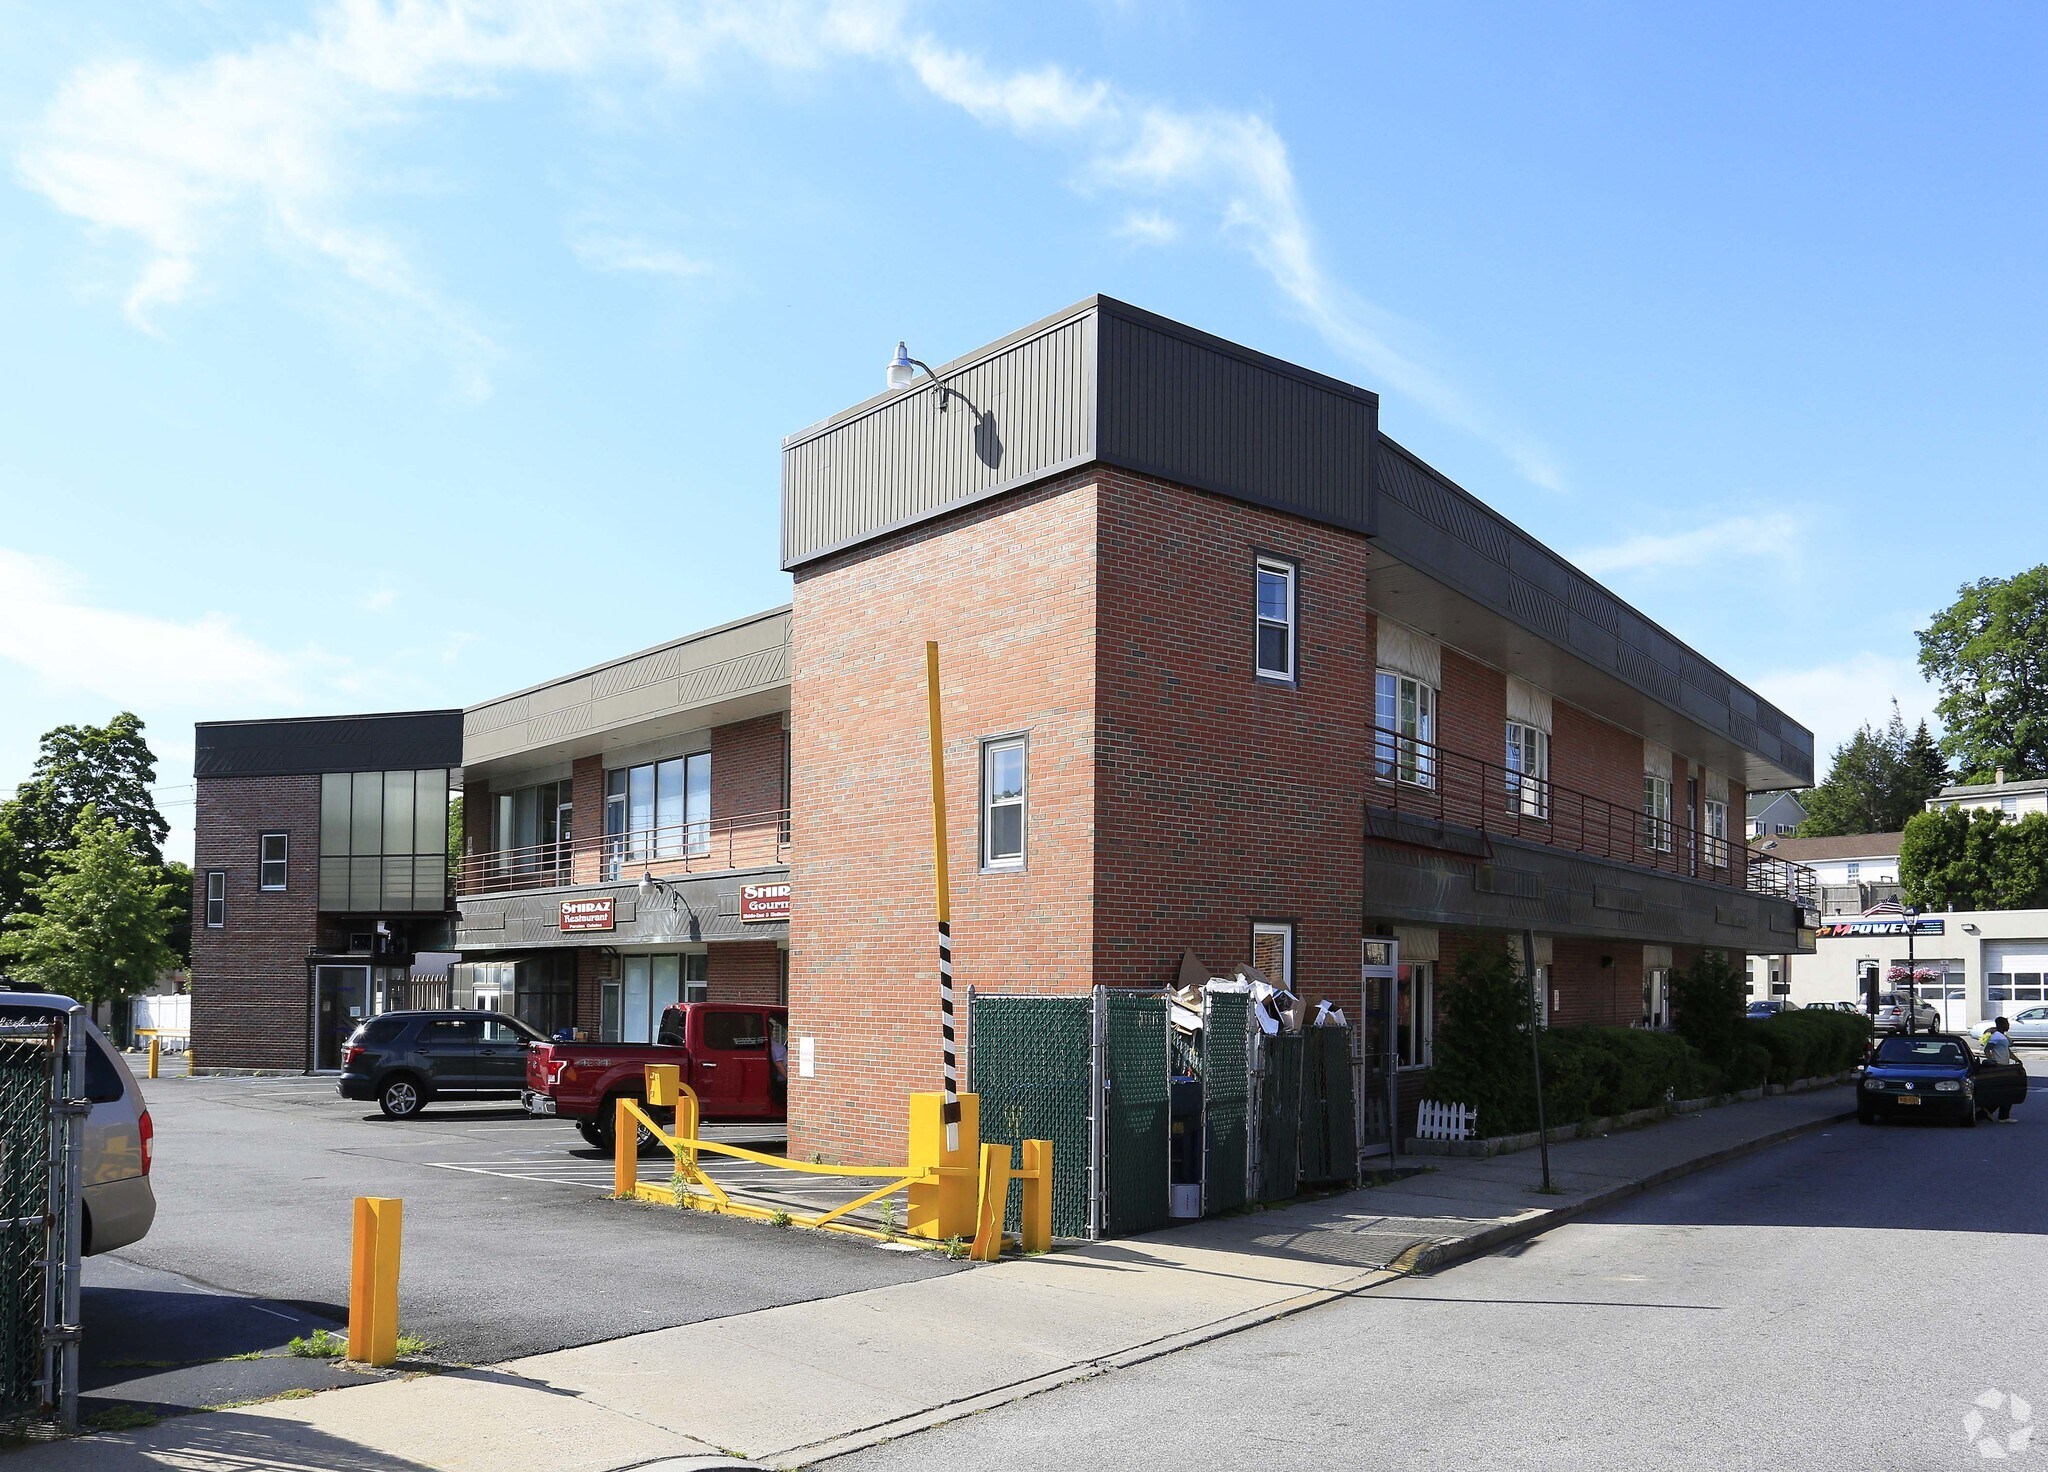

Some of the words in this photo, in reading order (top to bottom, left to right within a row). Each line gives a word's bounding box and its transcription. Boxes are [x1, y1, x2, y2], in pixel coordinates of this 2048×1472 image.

[744, 885, 790, 899] SHIR
[561, 901, 611, 914] SHIRAZ
[564, 913, 608, 923] Restaurant
